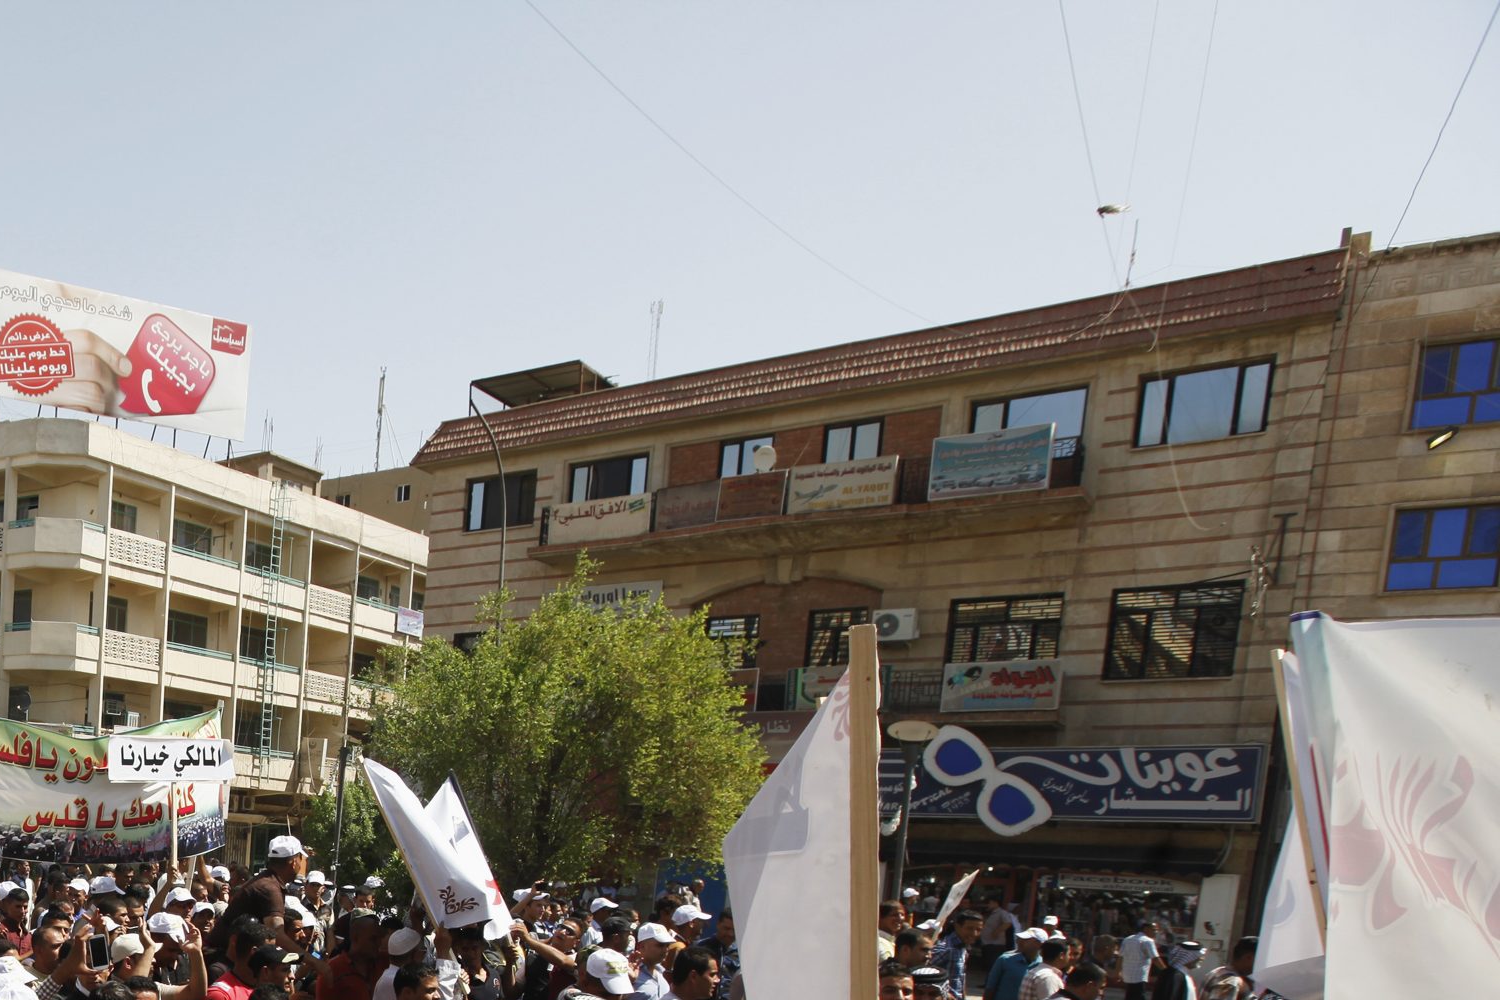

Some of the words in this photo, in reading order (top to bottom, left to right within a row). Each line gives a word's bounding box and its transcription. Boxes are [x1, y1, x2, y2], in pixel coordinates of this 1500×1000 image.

[7, 332, 28, 344] دائم
[28, 331, 51, 342] عرض
[28, 350, 47, 361] يوم
[49, 348, 66, 358] خط
[38, 363, 68, 375] ويوم
[120, 743, 169, 772] خيارنا
[174, 744, 221, 777] المالكي
[1000, 747, 1241, 795] عوينات
[22, 797, 90, 834] قدس
[95, 800, 118, 842] يا
[122, 796, 163, 828] معك
[1060, 875, 1173, 886] Facebook
